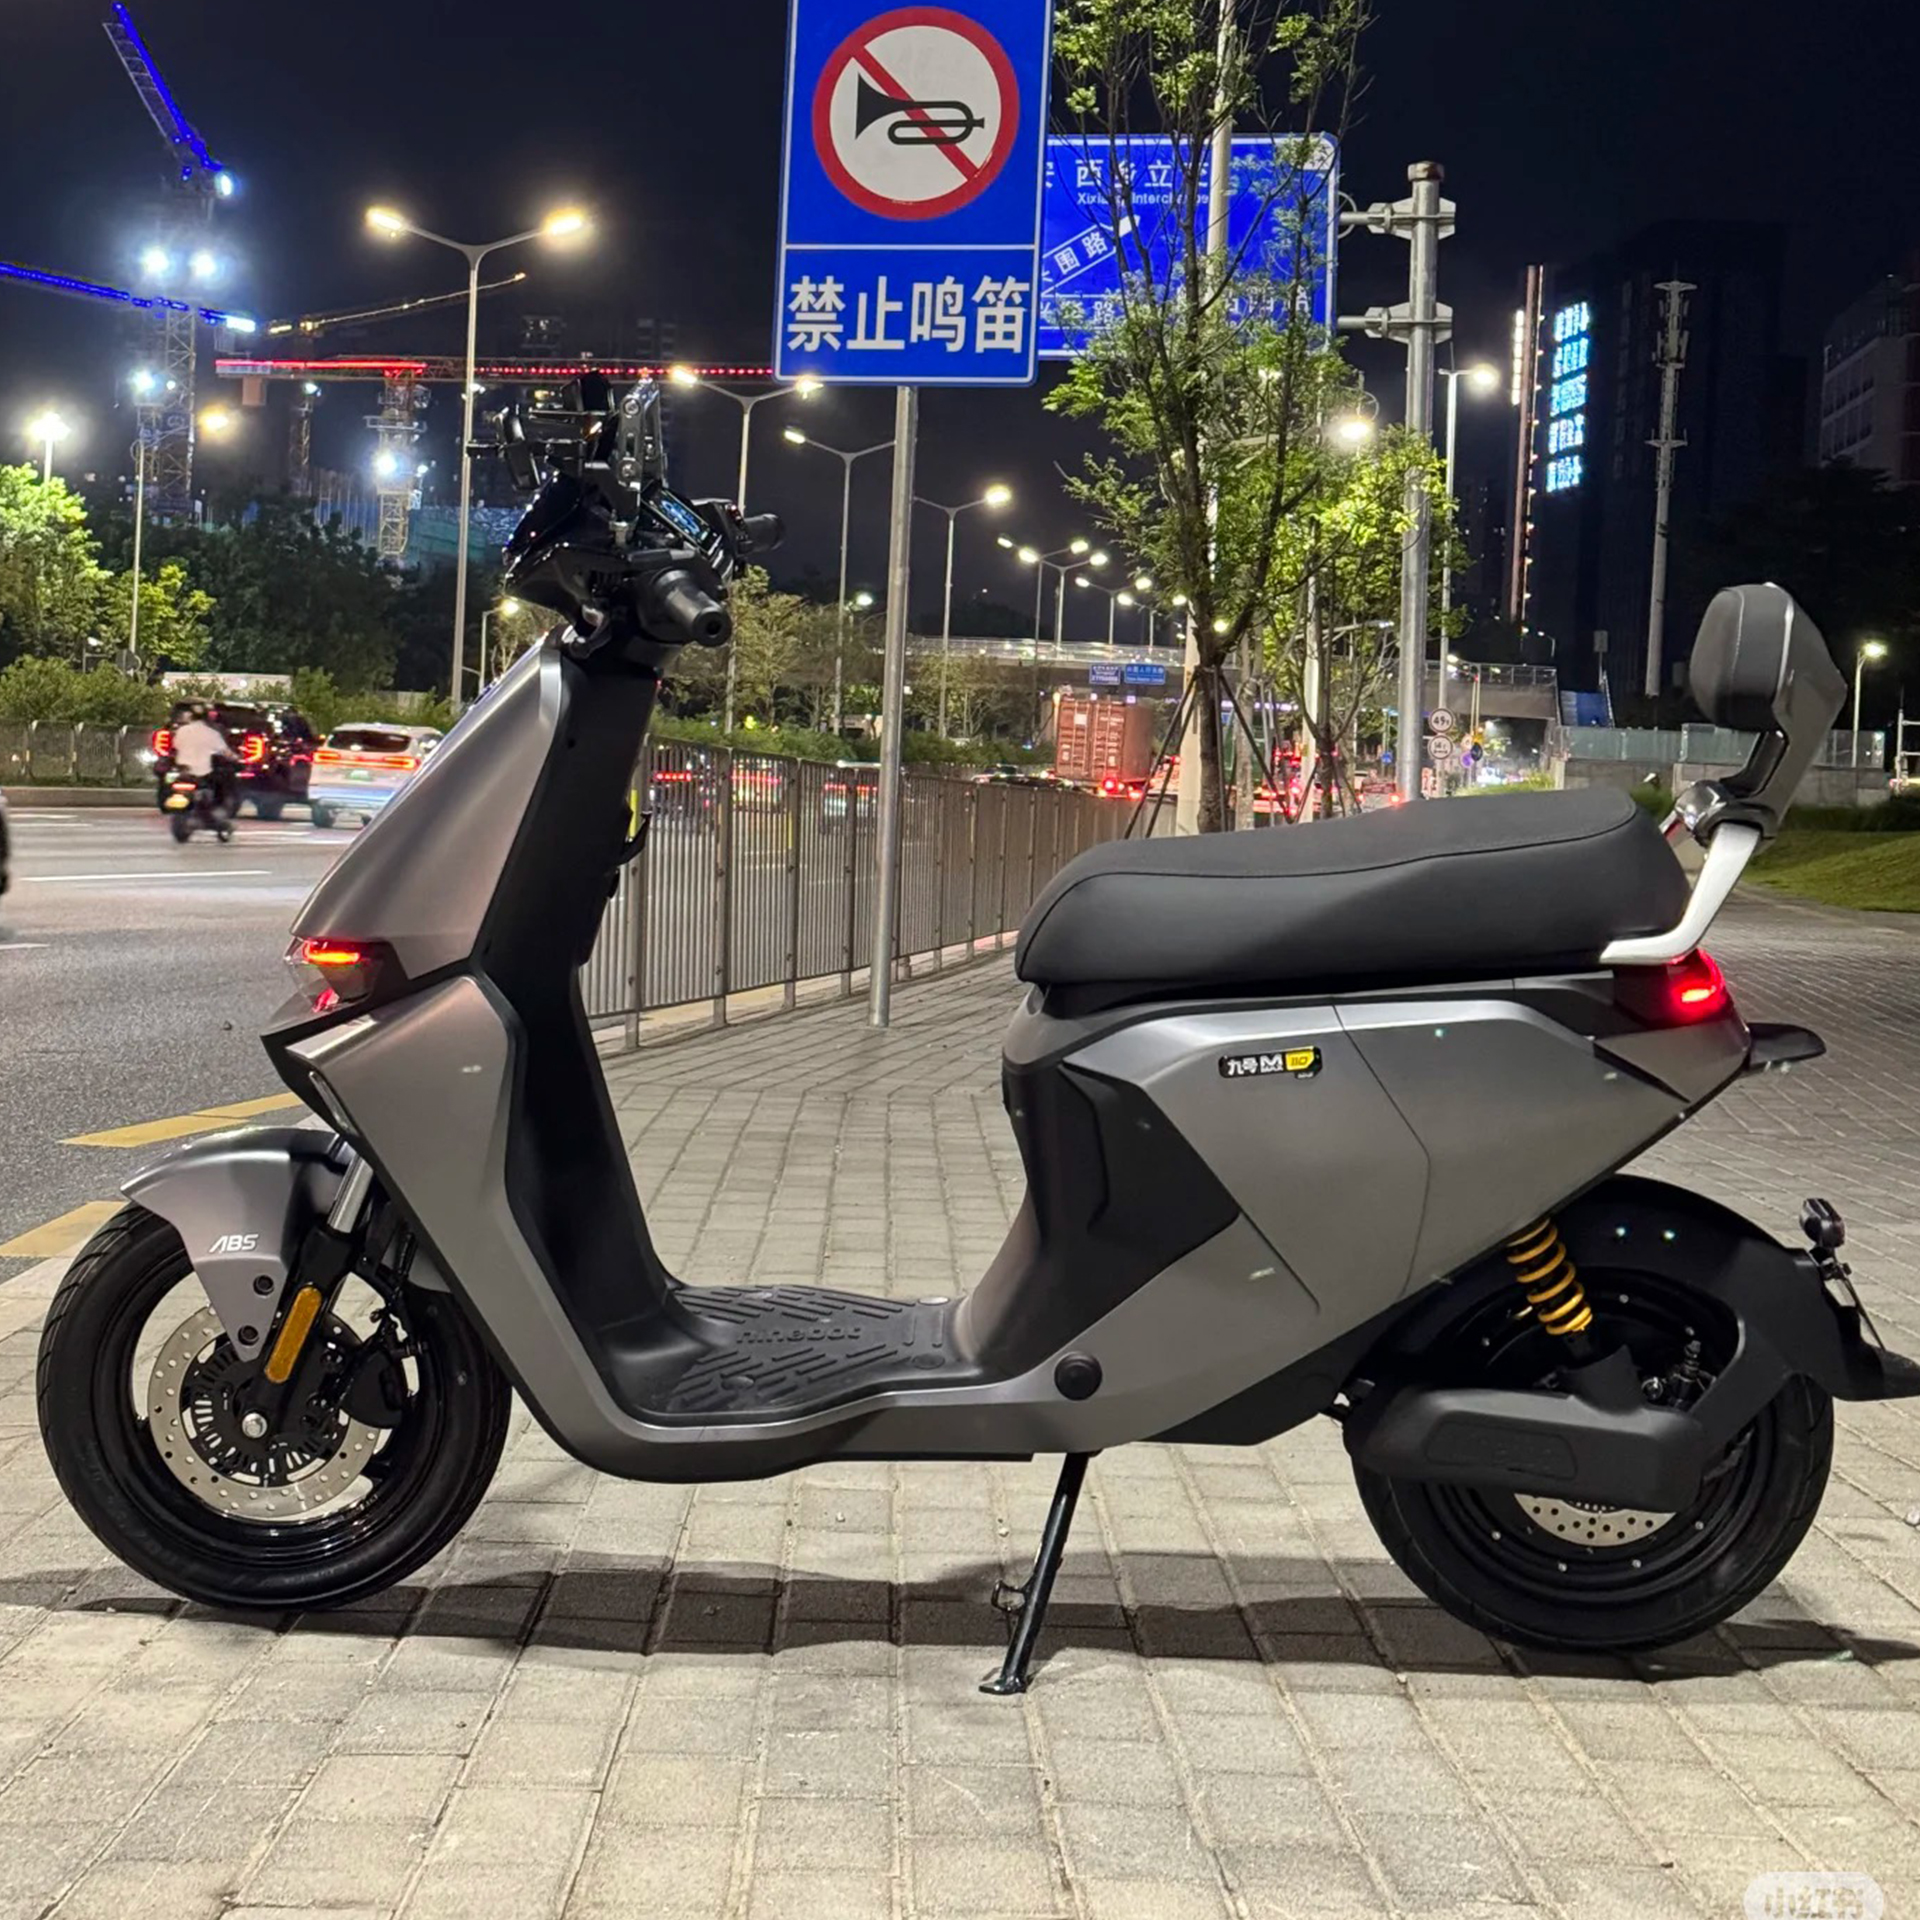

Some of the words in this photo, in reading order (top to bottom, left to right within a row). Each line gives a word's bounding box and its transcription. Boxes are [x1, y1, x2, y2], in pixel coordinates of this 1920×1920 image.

[787, 275, 1030, 353] 禁止鸣笛
[209, 1233, 259, 1254] ABS
